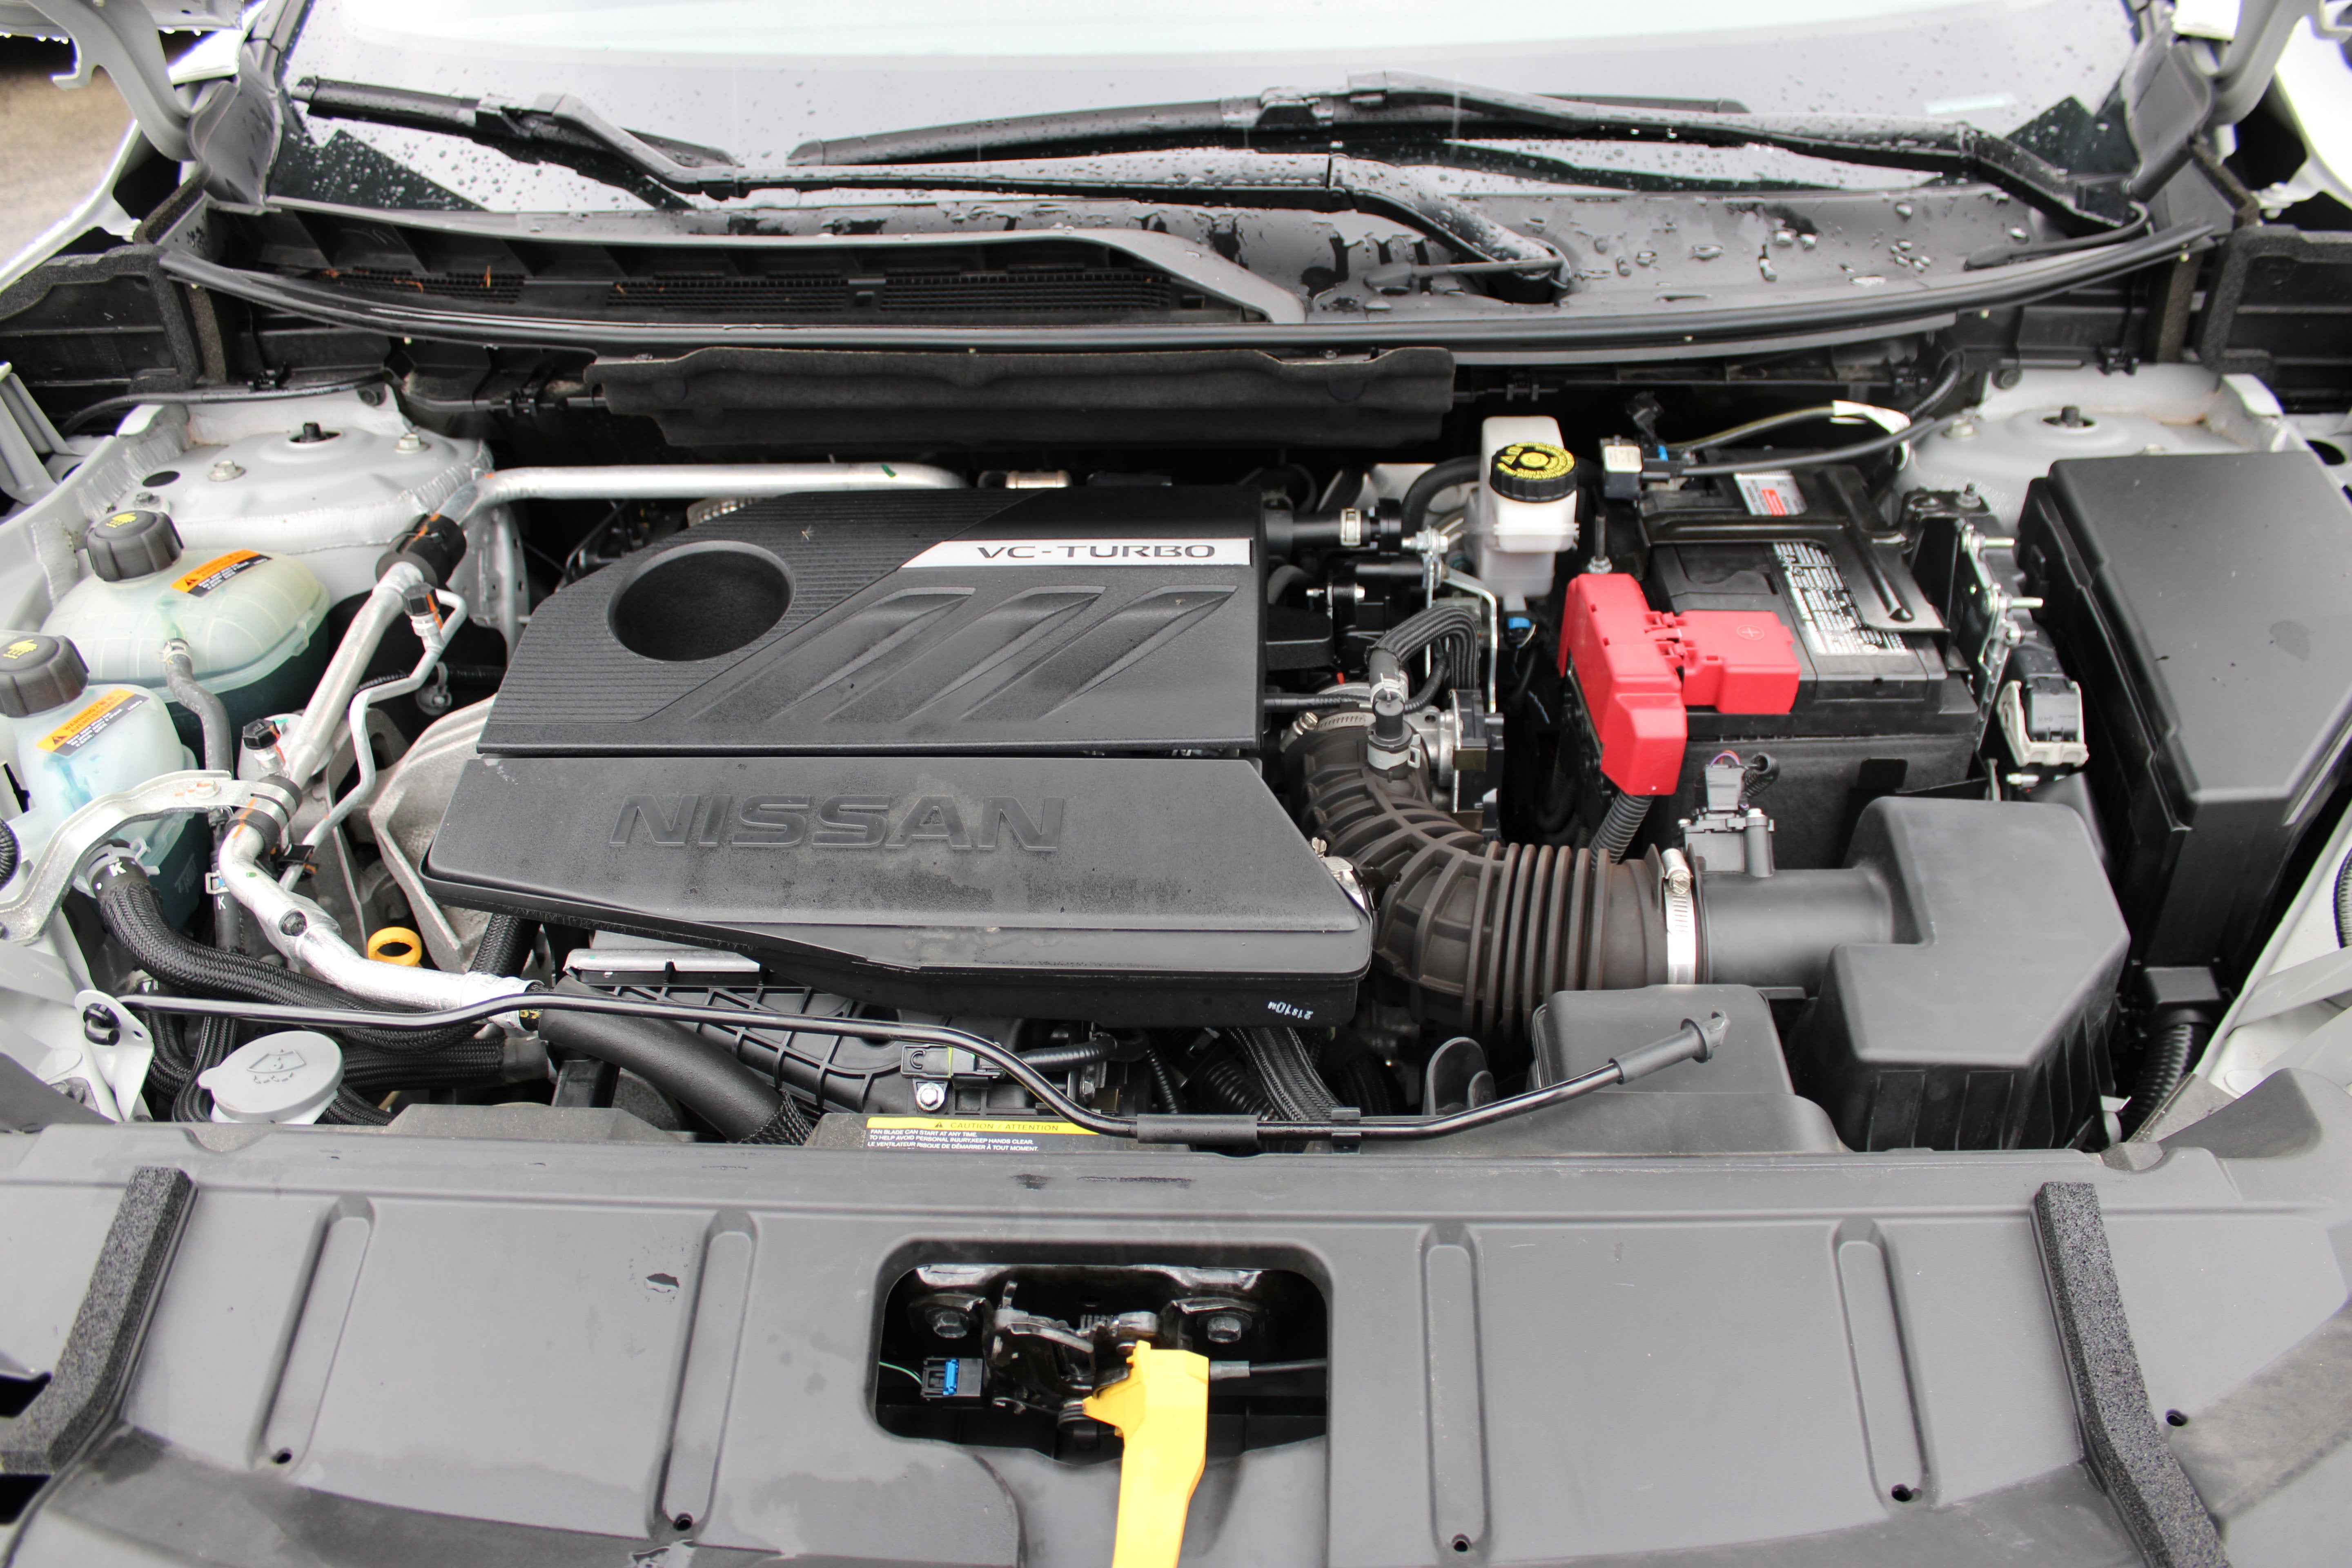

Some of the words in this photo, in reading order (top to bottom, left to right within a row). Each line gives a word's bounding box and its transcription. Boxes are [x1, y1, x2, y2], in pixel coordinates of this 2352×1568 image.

[977, 545, 1216, 559] VC-TURBO
[609, 793, 1065, 851] NISSAN
[109, 862, 127, 877] K
[217, 895, 226, 910] K
